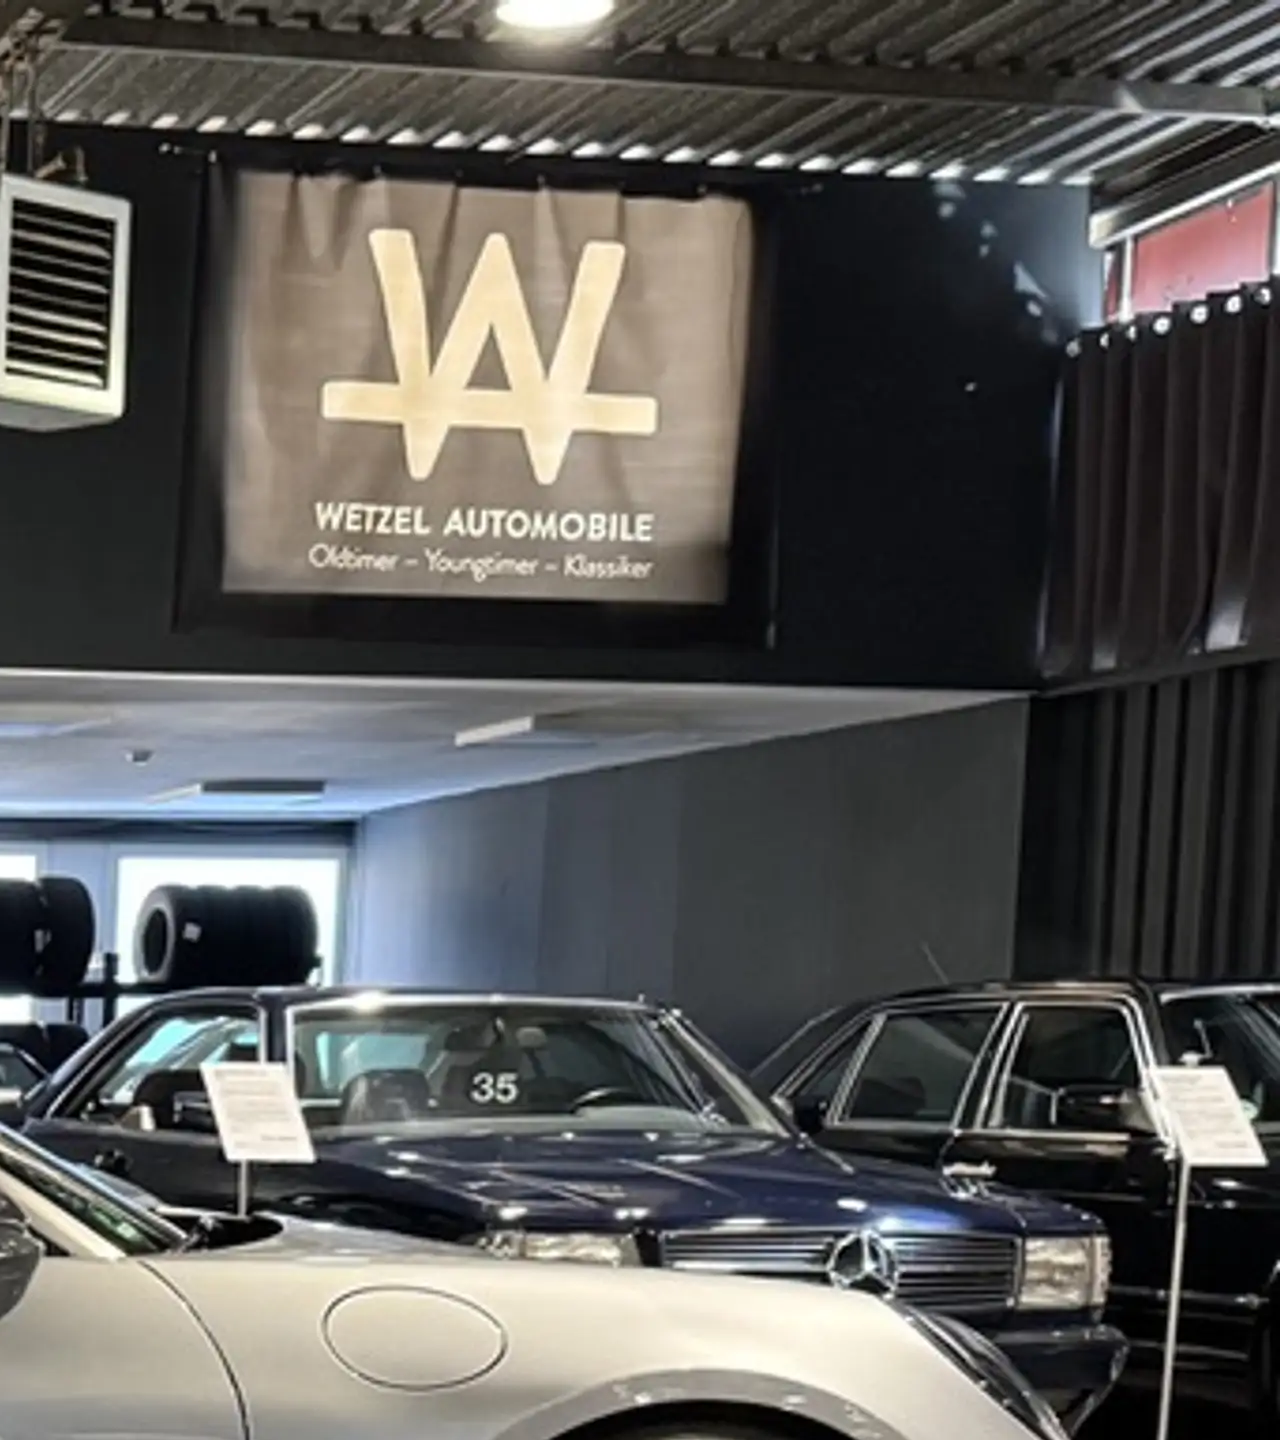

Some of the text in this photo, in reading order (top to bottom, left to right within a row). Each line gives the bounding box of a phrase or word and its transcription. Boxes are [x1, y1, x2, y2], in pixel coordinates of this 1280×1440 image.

[315, 502, 655, 543] WETZEL AUTOMOBILE
[308, 543, 398, 573] Oldtimer
[424, 548, 539, 584] Youngtimer
[563, 553, 653, 580] Klassiker
[470, 1071, 519, 1104] 35
